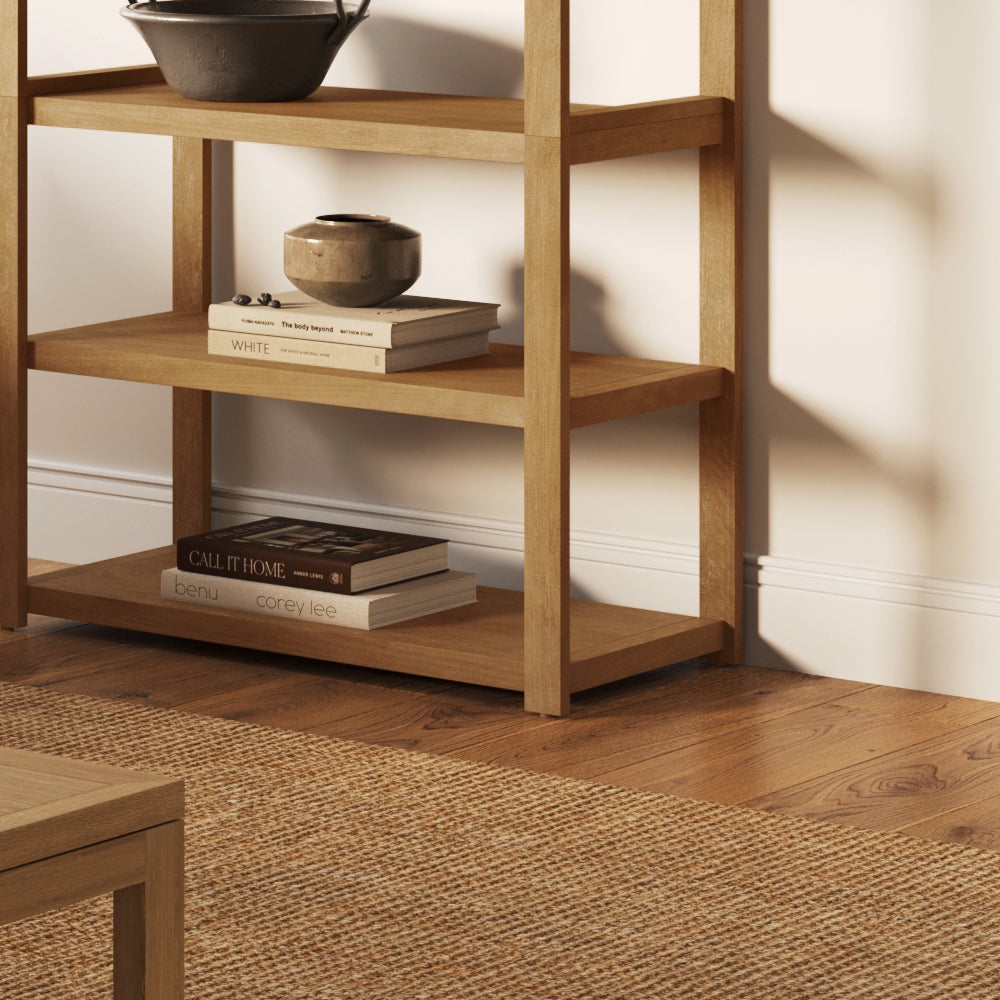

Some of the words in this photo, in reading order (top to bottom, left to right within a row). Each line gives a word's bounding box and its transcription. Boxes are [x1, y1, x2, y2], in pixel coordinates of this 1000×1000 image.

[281, 320, 293, 330] The
[294, 322, 310, 333] body
[311, 324, 334, 334] beyond
[231, 339, 270, 355] WHITE
[189, 550, 224, 570] CALL
[227, 555, 241, 572] IT
[243, 558, 286, 579] HOME
[174, 574, 218, 601] benu
[256, 593, 305, 616] corey
[309, 600, 337, 618] lee
